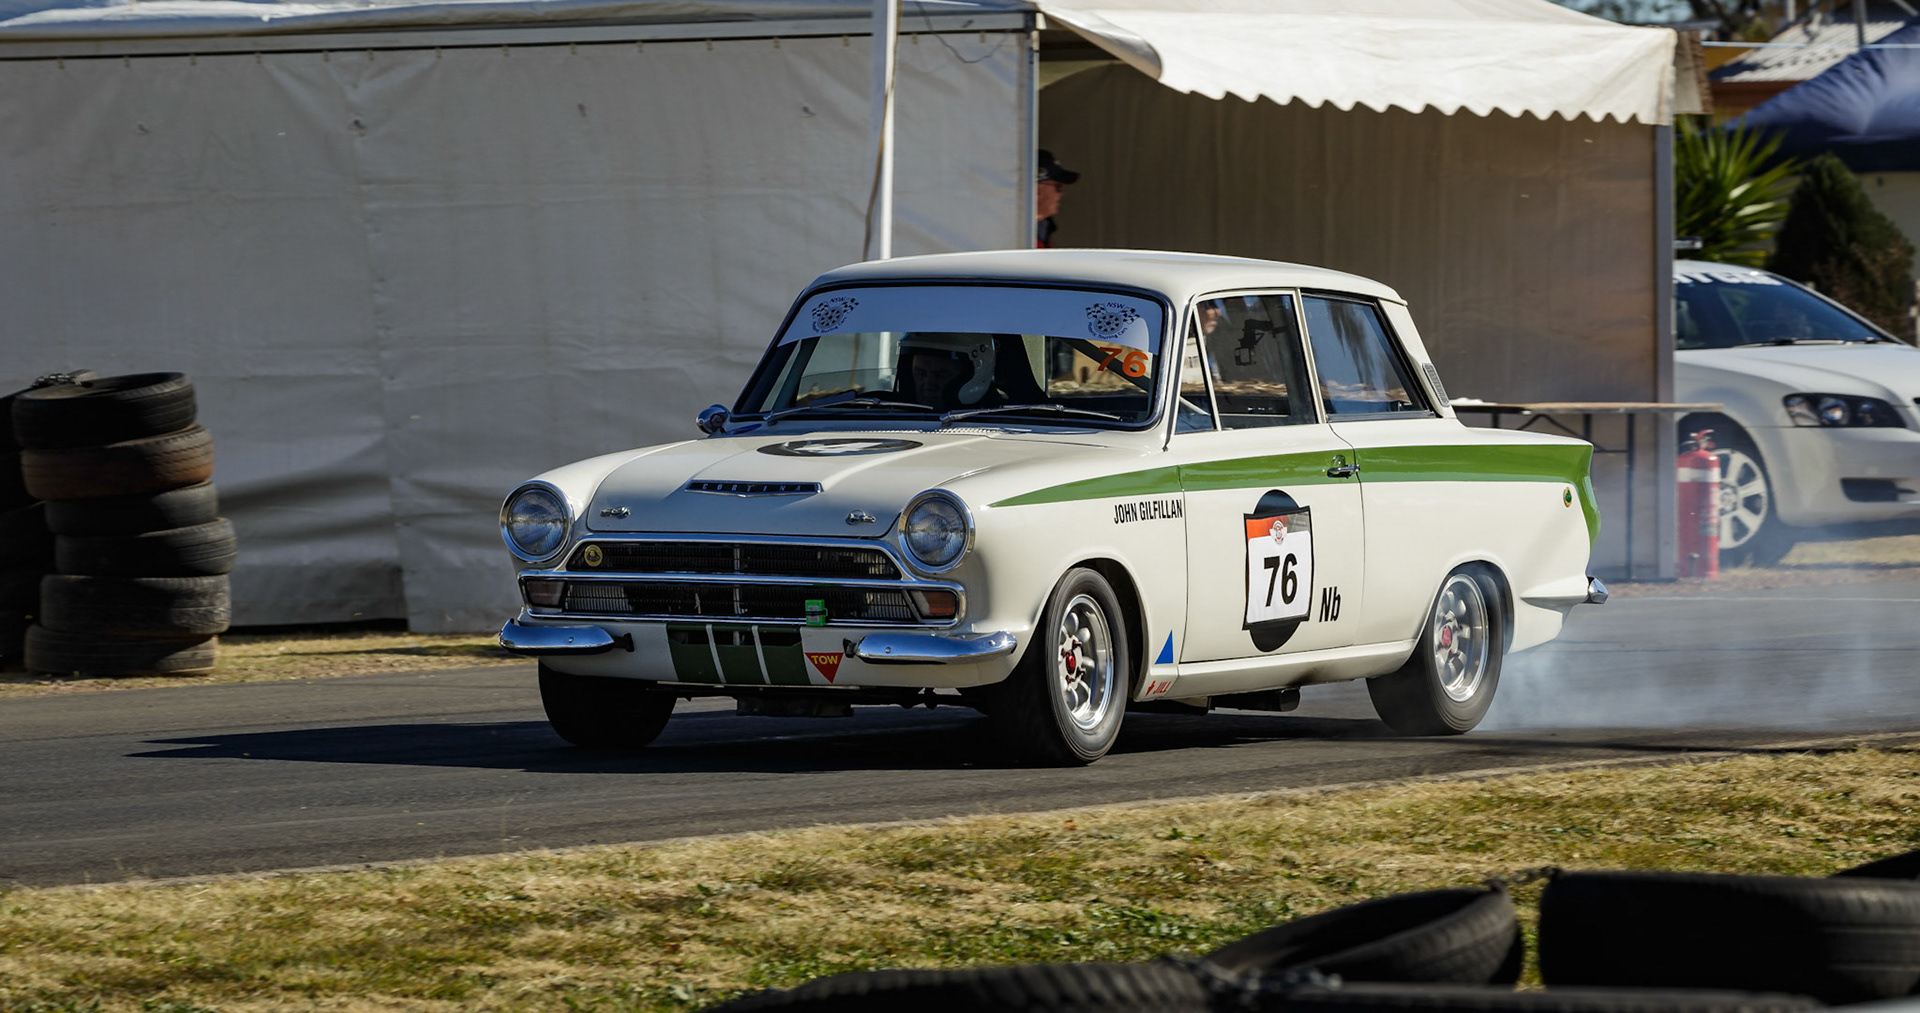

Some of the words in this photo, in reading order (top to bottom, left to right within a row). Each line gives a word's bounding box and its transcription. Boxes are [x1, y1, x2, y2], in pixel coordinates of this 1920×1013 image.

[1097, 346, 1149, 378] 76
[702, 483, 802, 492] CORTINA
[1114, 502, 1138, 525] JOHN
[1139, 499, 1183, 520] GILFILLAN
[1263, 553, 1298, 608] 76
[1319, 586, 1341, 623] Nb
[811, 655, 838, 665] TOW
